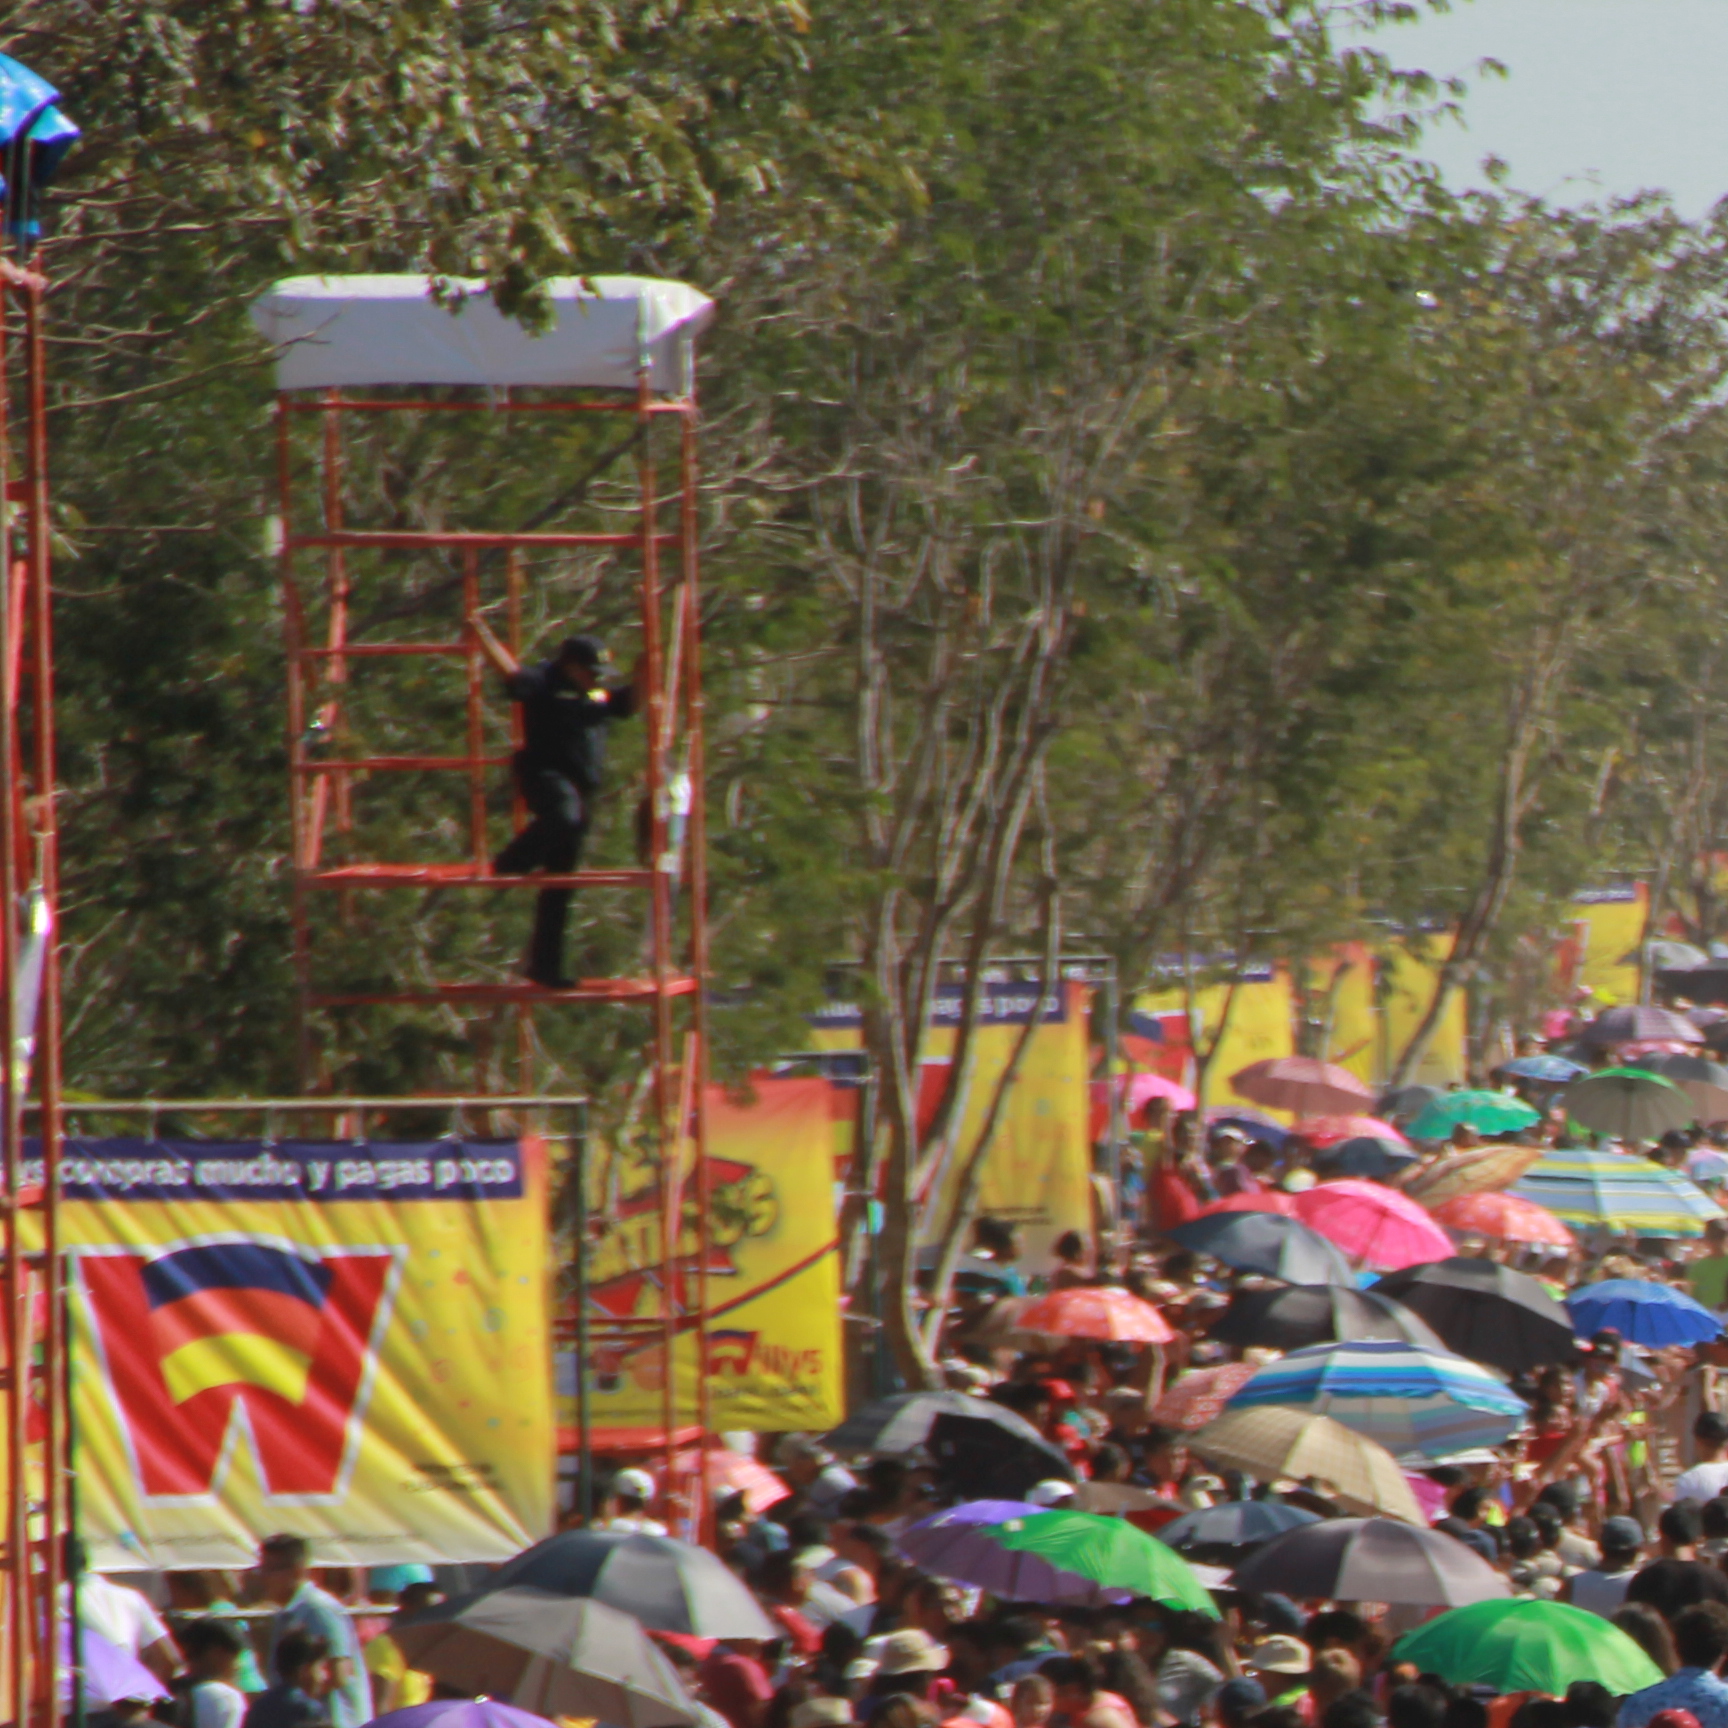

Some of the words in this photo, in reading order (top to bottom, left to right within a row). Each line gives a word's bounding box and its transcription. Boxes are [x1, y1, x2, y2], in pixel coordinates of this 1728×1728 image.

[196, 1154, 301, 1186] mucho
[306, 1161, 332, 1191] y
[334, 1159, 433, 1191] pagas
[435, 1159, 516, 1191] poco
